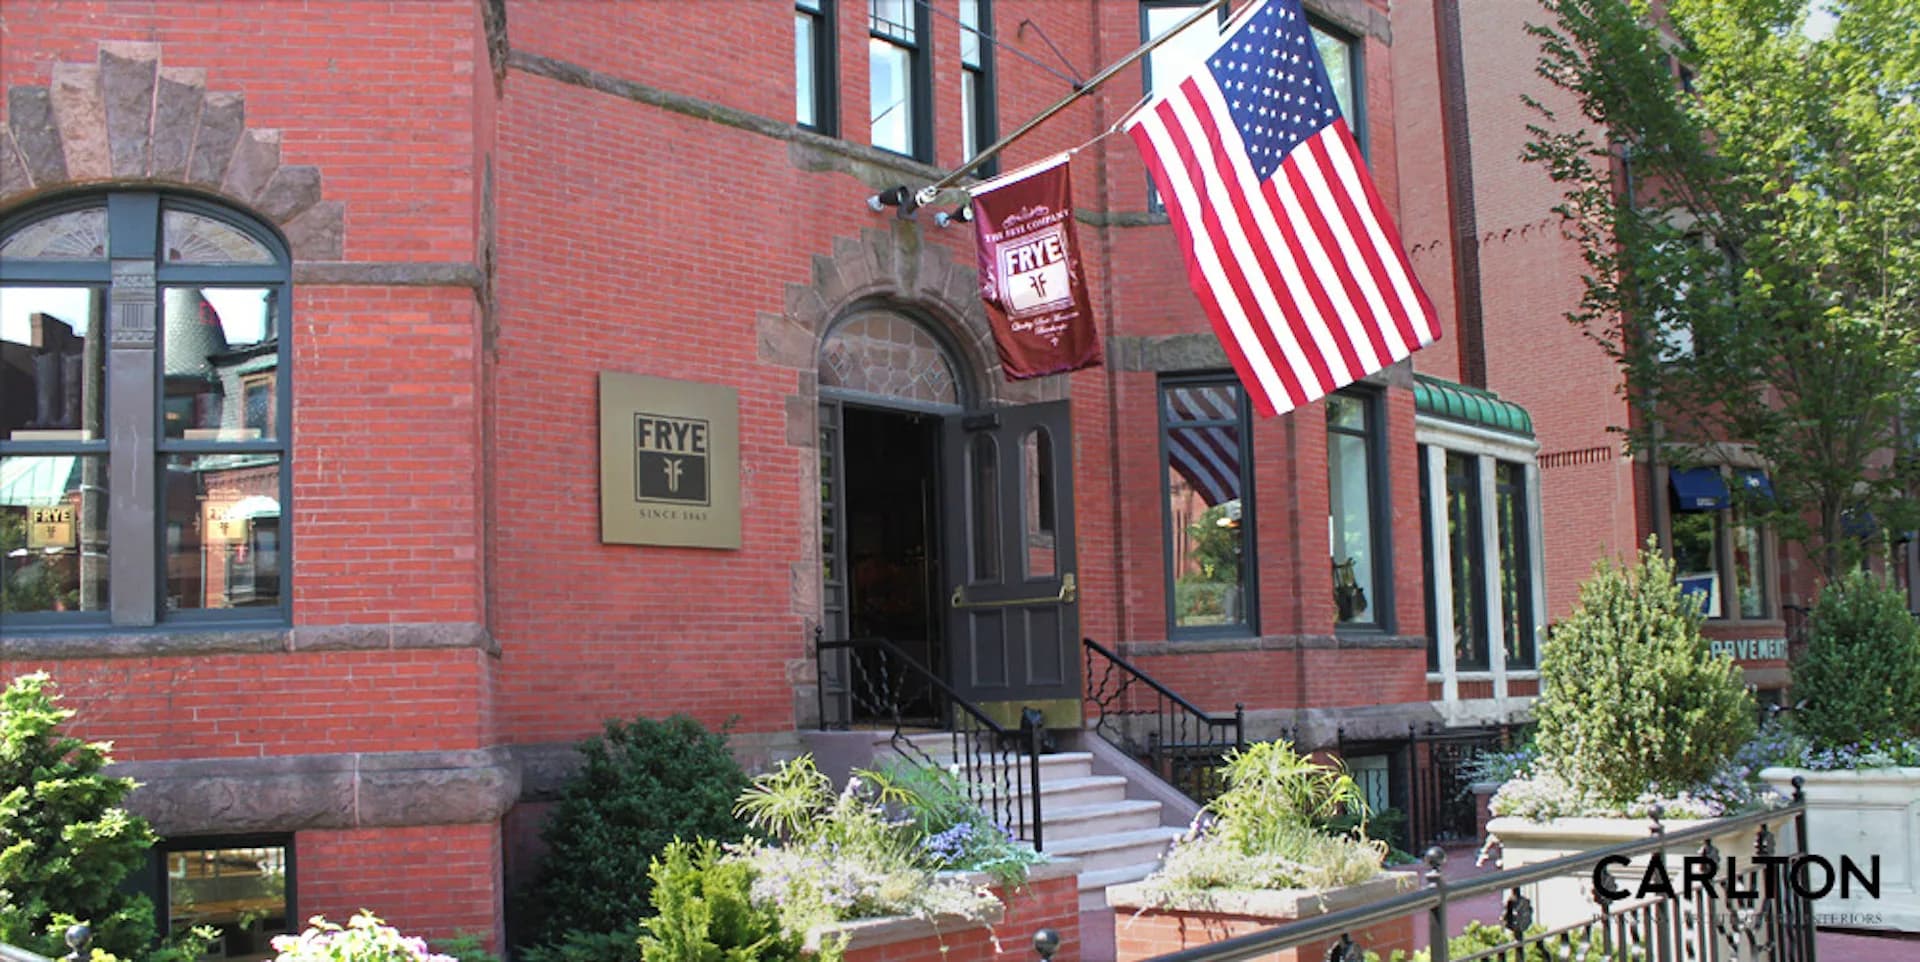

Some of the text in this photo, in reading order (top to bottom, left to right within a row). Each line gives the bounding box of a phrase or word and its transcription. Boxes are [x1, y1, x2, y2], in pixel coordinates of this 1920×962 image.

[1006, 235, 1063, 276] FRYE
[639, 418, 705, 453] FRYE
[34, 508, 70, 523] FRYE
[640, 508, 676, 520] SINCE
